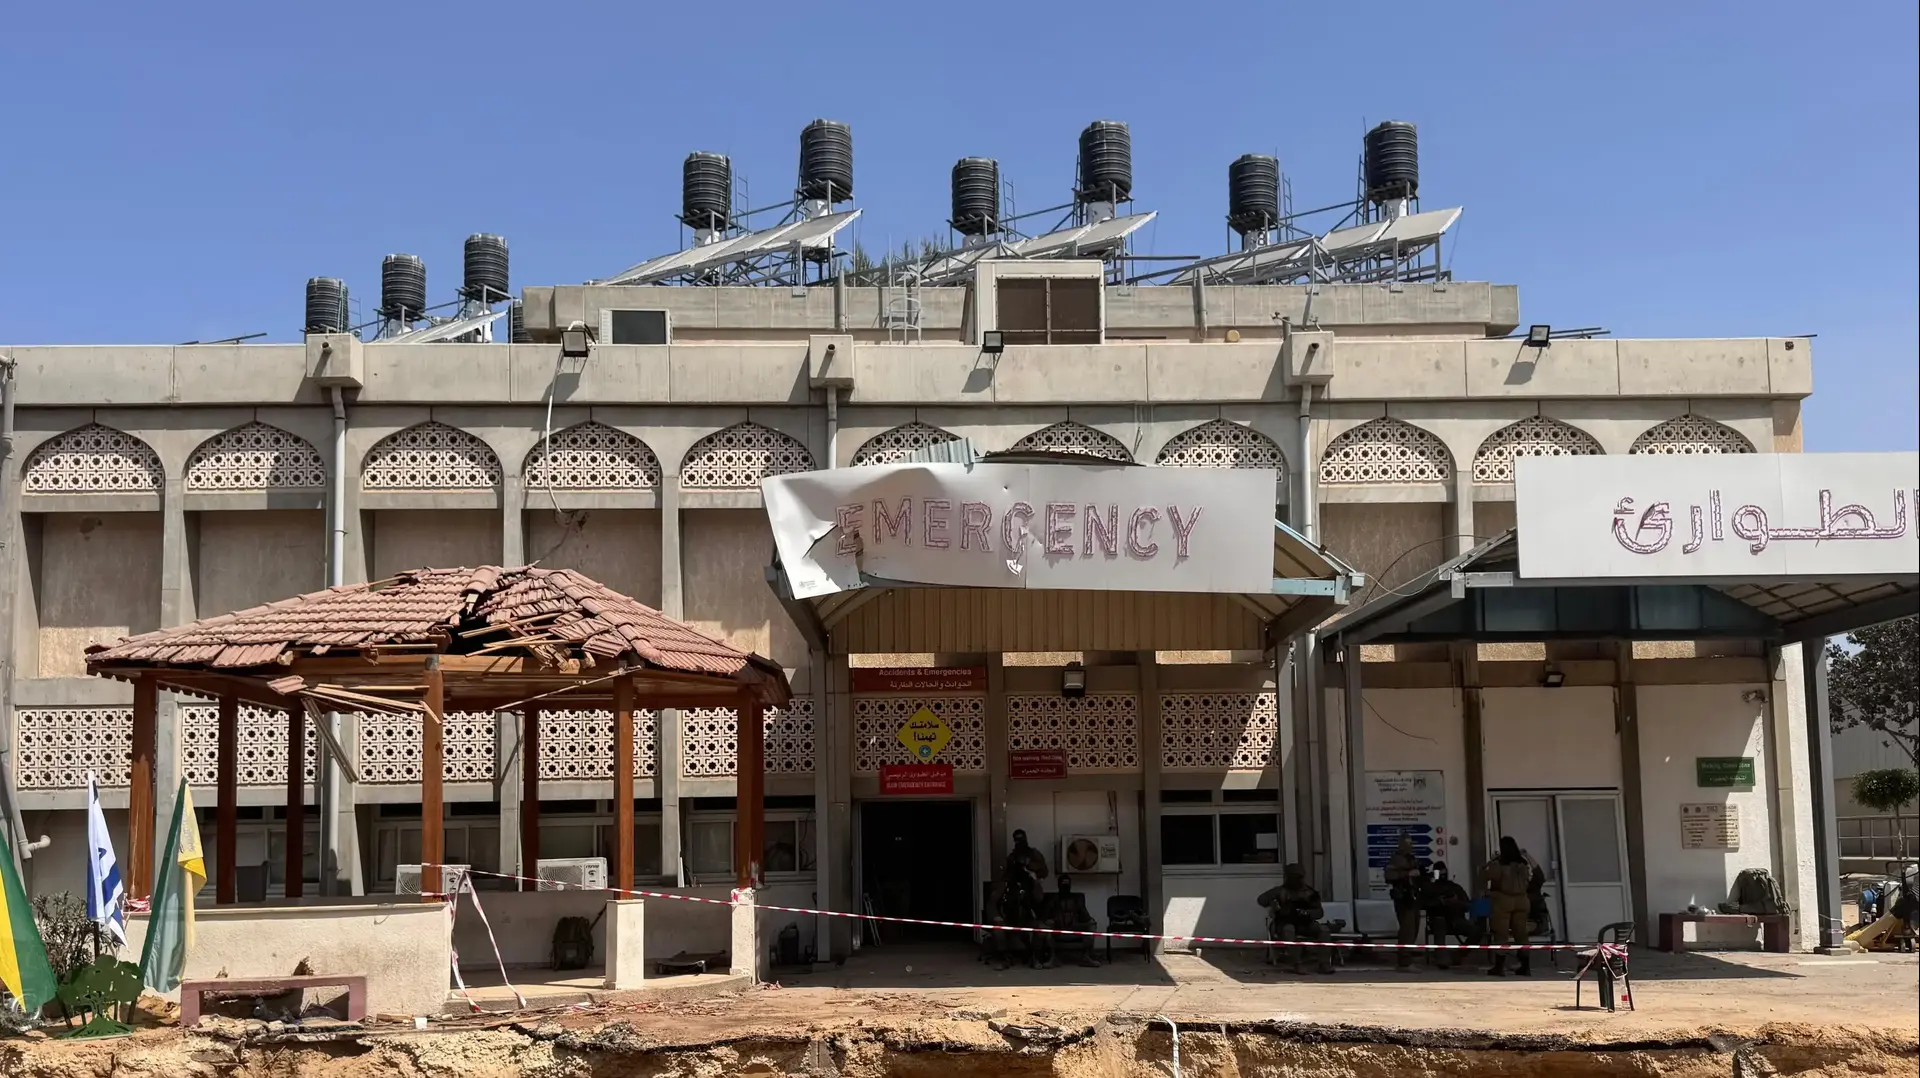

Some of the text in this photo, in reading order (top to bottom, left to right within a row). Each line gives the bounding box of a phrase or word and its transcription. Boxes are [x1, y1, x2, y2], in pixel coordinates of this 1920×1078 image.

[833, 495, 1204, 559] EMERGENCY
[878, 668, 972, 677] Accidents & Emergencies
